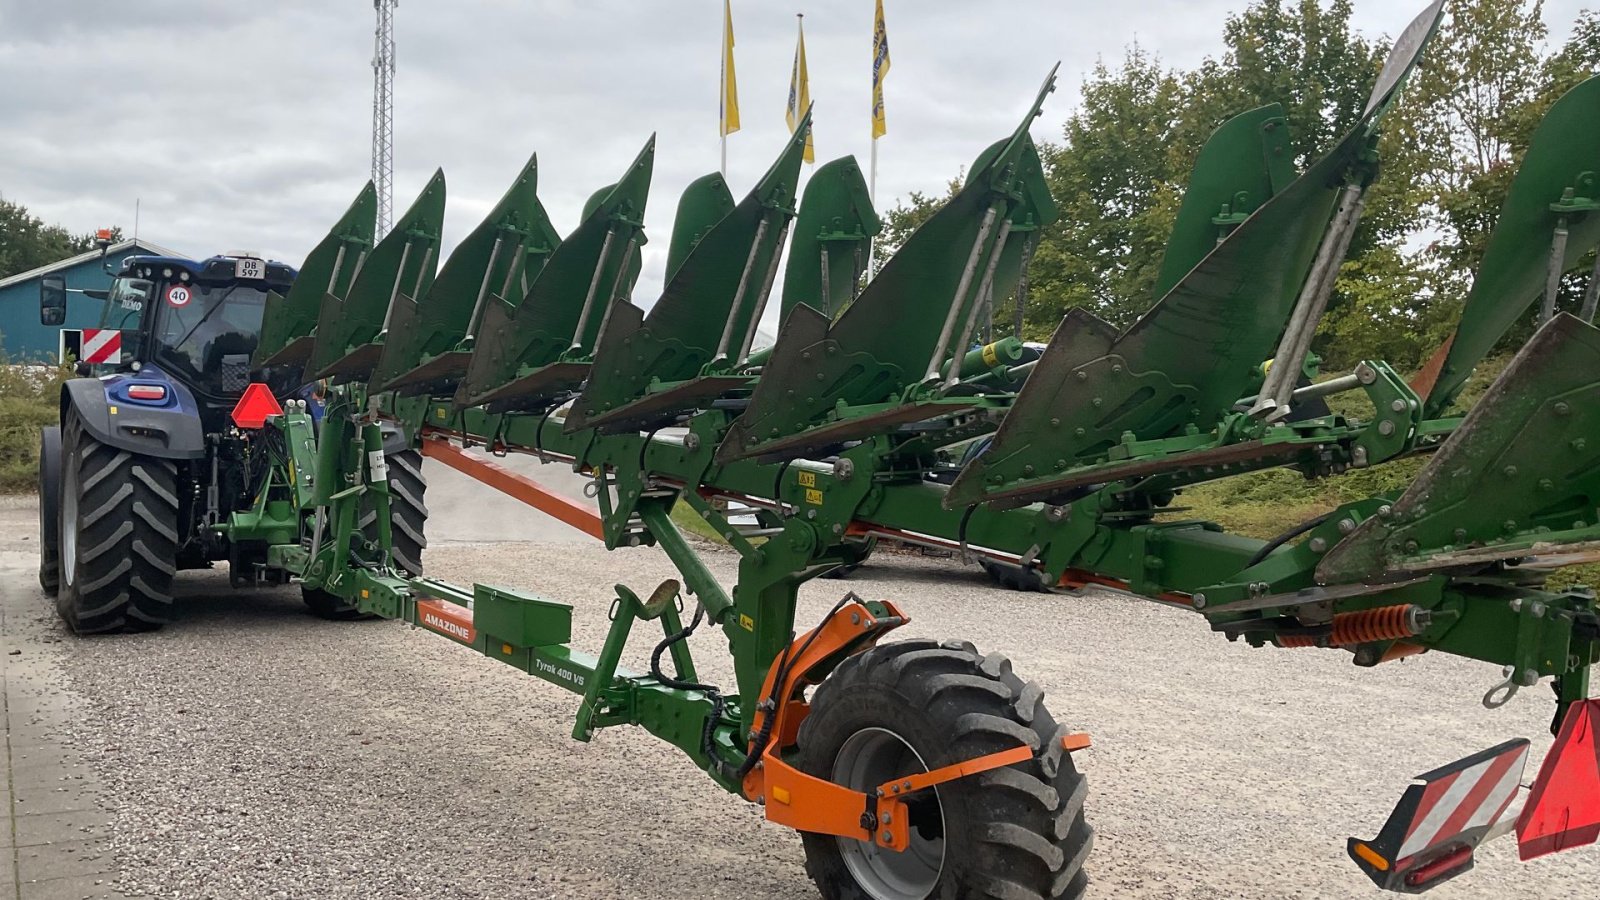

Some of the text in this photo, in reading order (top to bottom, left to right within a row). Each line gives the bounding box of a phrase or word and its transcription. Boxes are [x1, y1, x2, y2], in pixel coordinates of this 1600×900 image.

[244, 261, 257, 269] DB
[242, 269, 258, 277] 597
[171, 290, 186, 301] 40
[121, 299, 142, 311] DEMO
[425, 613, 469, 639] AMAZONE
[536, 658, 556, 675] Tyrok
[557, 668, 572, 681] 400
